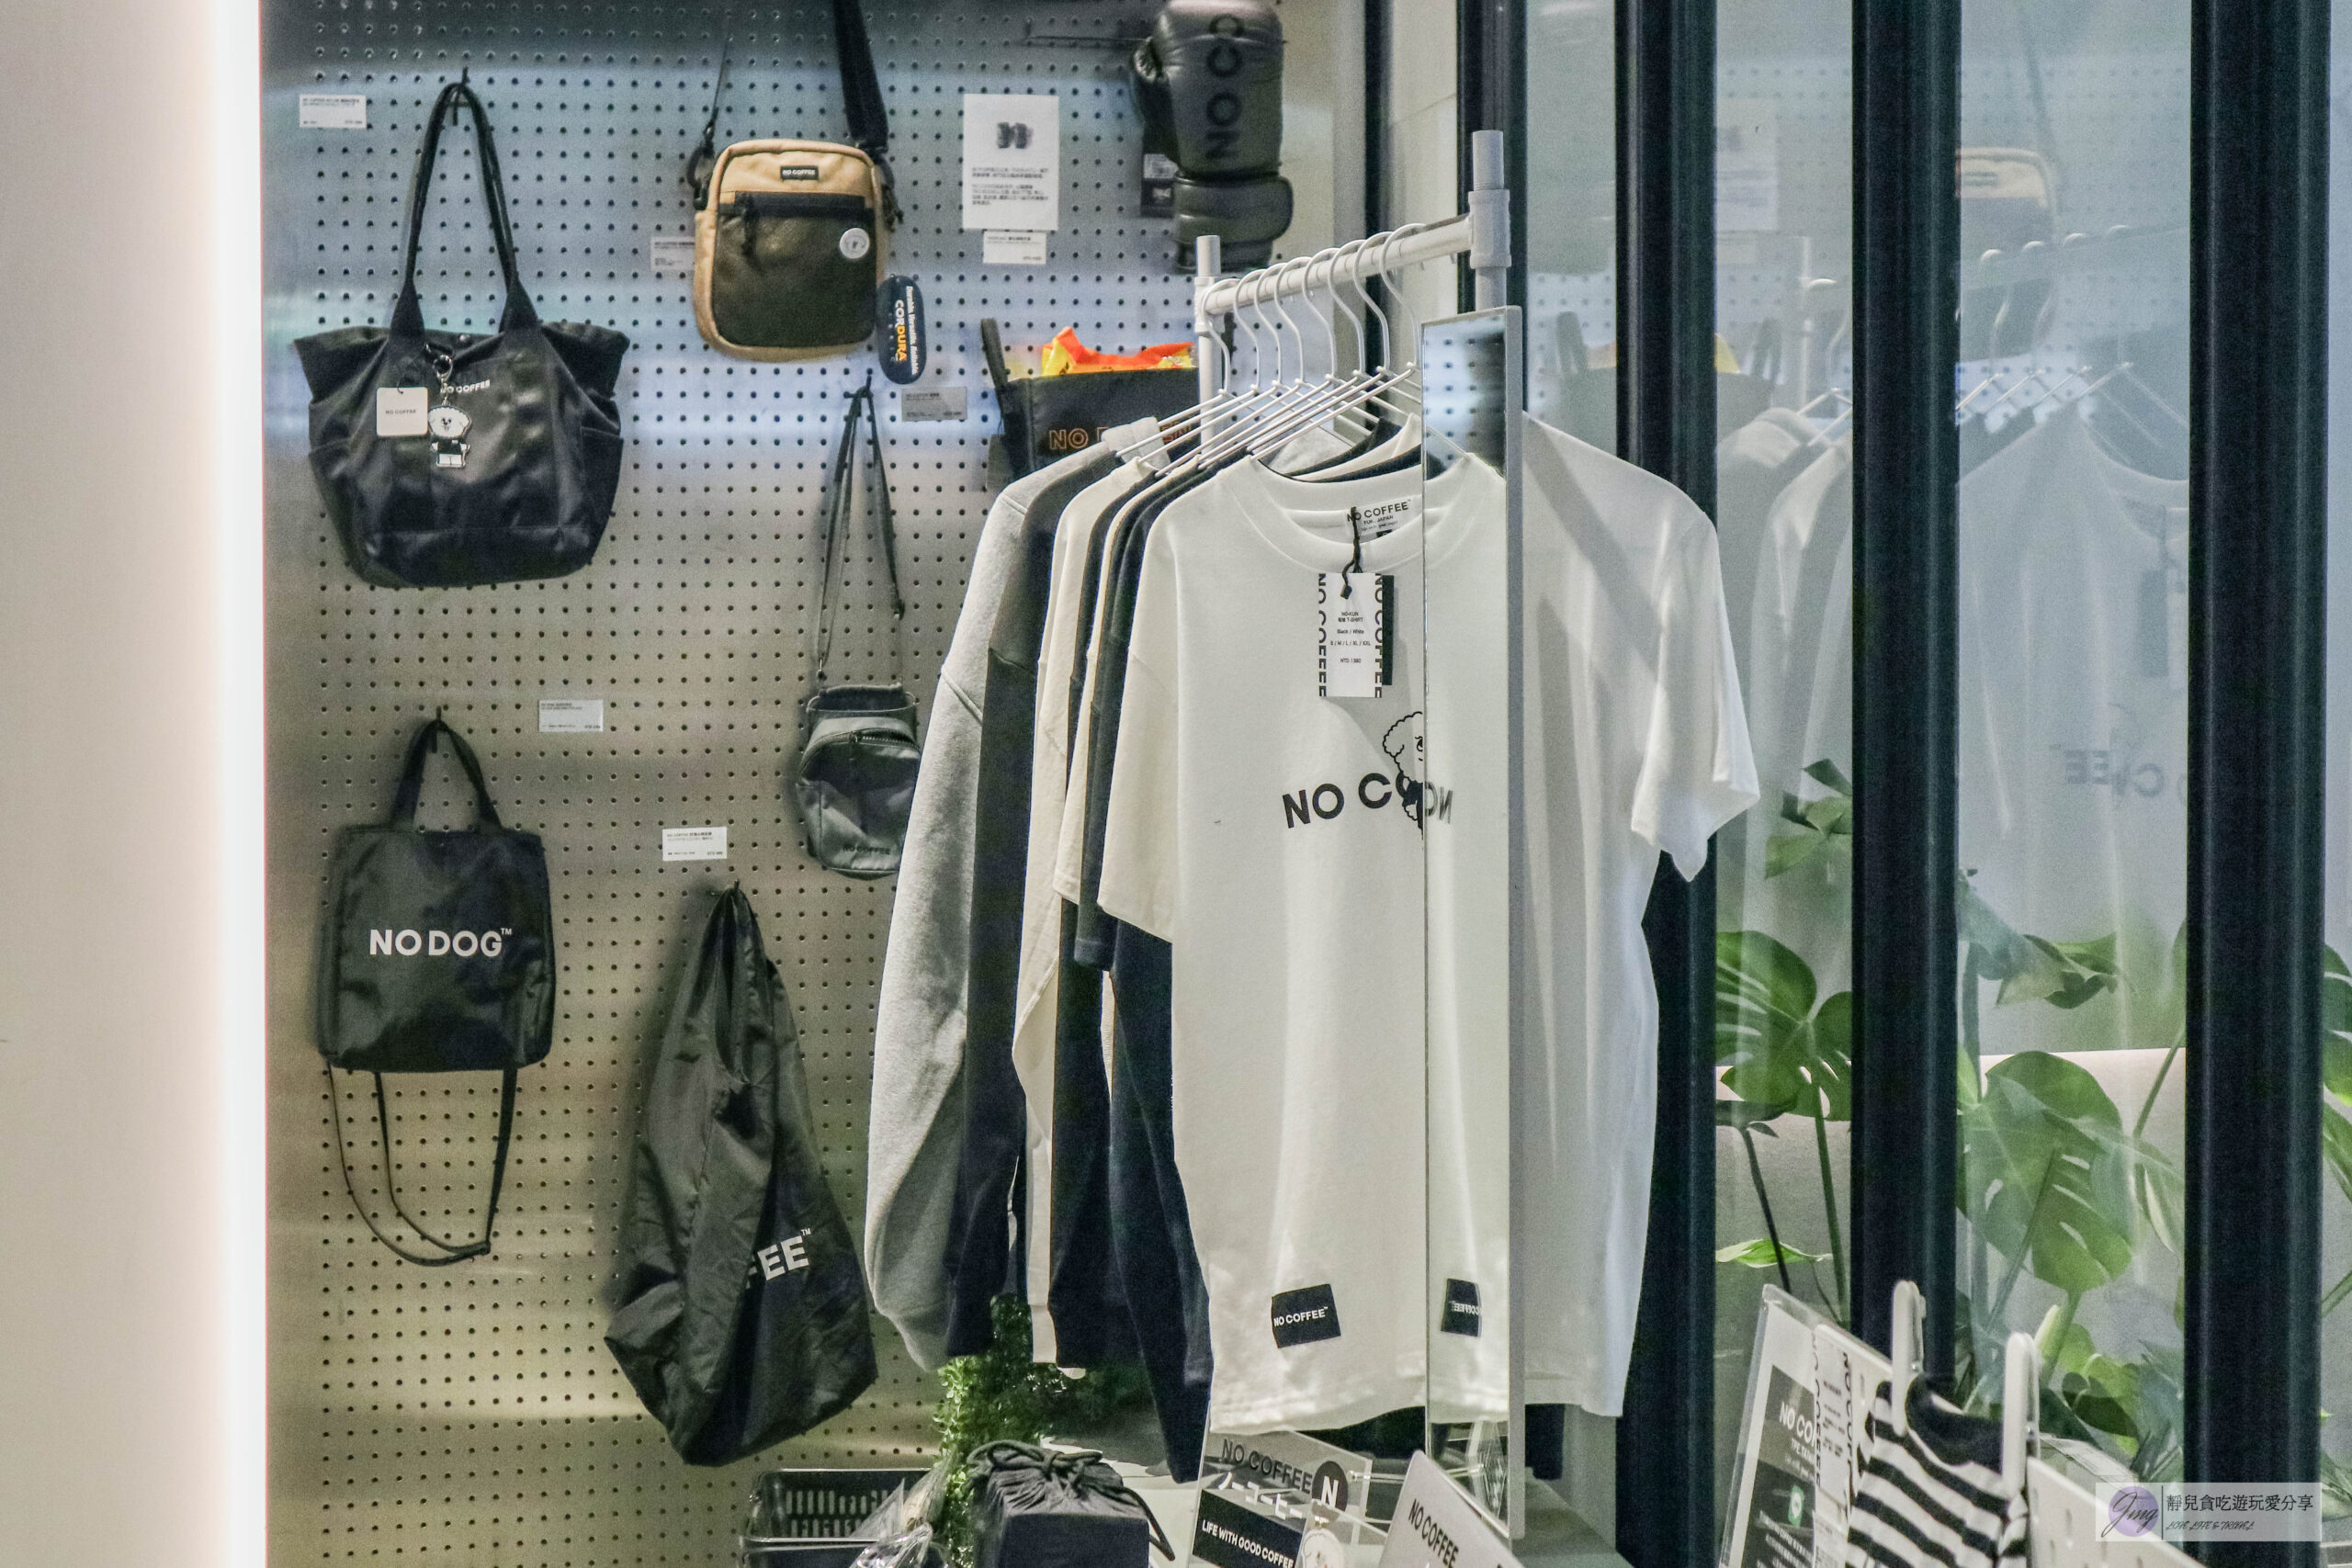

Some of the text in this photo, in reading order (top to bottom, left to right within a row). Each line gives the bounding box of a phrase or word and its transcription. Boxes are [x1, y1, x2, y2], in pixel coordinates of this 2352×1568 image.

[895, 299, 908, 361] CORDURA
[1049, 427, 1089, 450] NO
[1363, 501, 1409, 518] COFFEE
[1282, 784, 1345, 829] NO
[369, 929, 423, 956] NO
[1273, 1308, 1327, 1327] NO COFFEE
[1221, 1438, 1313, 1495] NO COFFEE
[1320, 1475, 1340, 1508] N
[1408, 1498, 1424, 1531] NO
[1202, 1520, 1218, 1539] LIFE
[1218, 1527, 1238, 1547] WITH
[1238, 1537, 1261, 1557] GOOD
